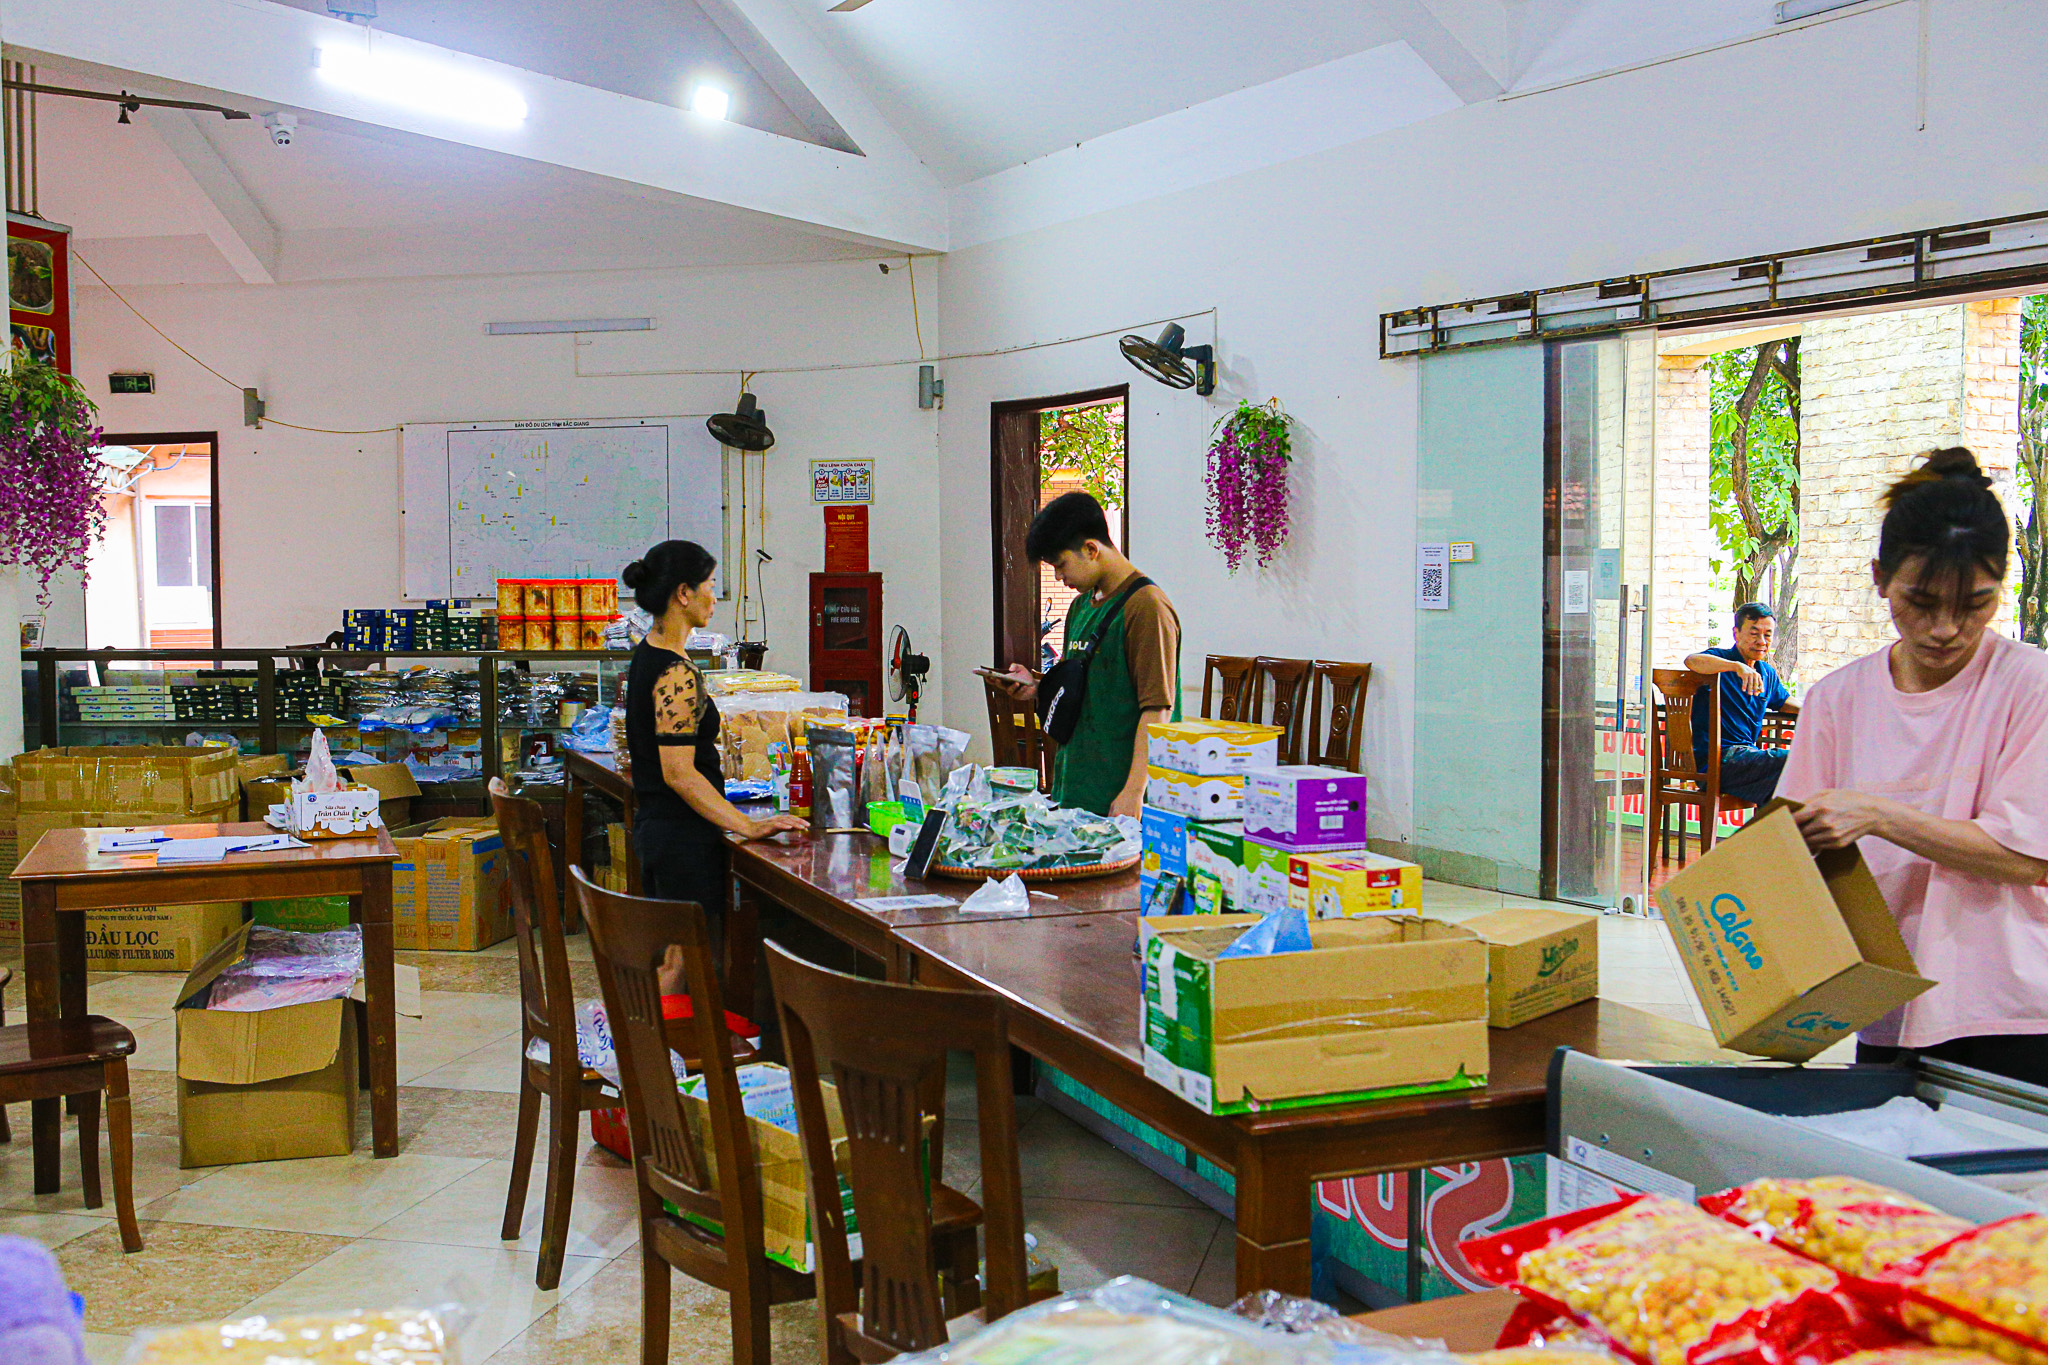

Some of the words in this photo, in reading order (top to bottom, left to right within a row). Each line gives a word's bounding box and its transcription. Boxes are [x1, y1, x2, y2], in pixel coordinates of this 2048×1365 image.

[86, 923, 121, 945] ĐẦU
[125, 931, 159, 948] LỌC
[122, 949, 151, 959] FILTER
[152, 949, 175, 959] RODS
